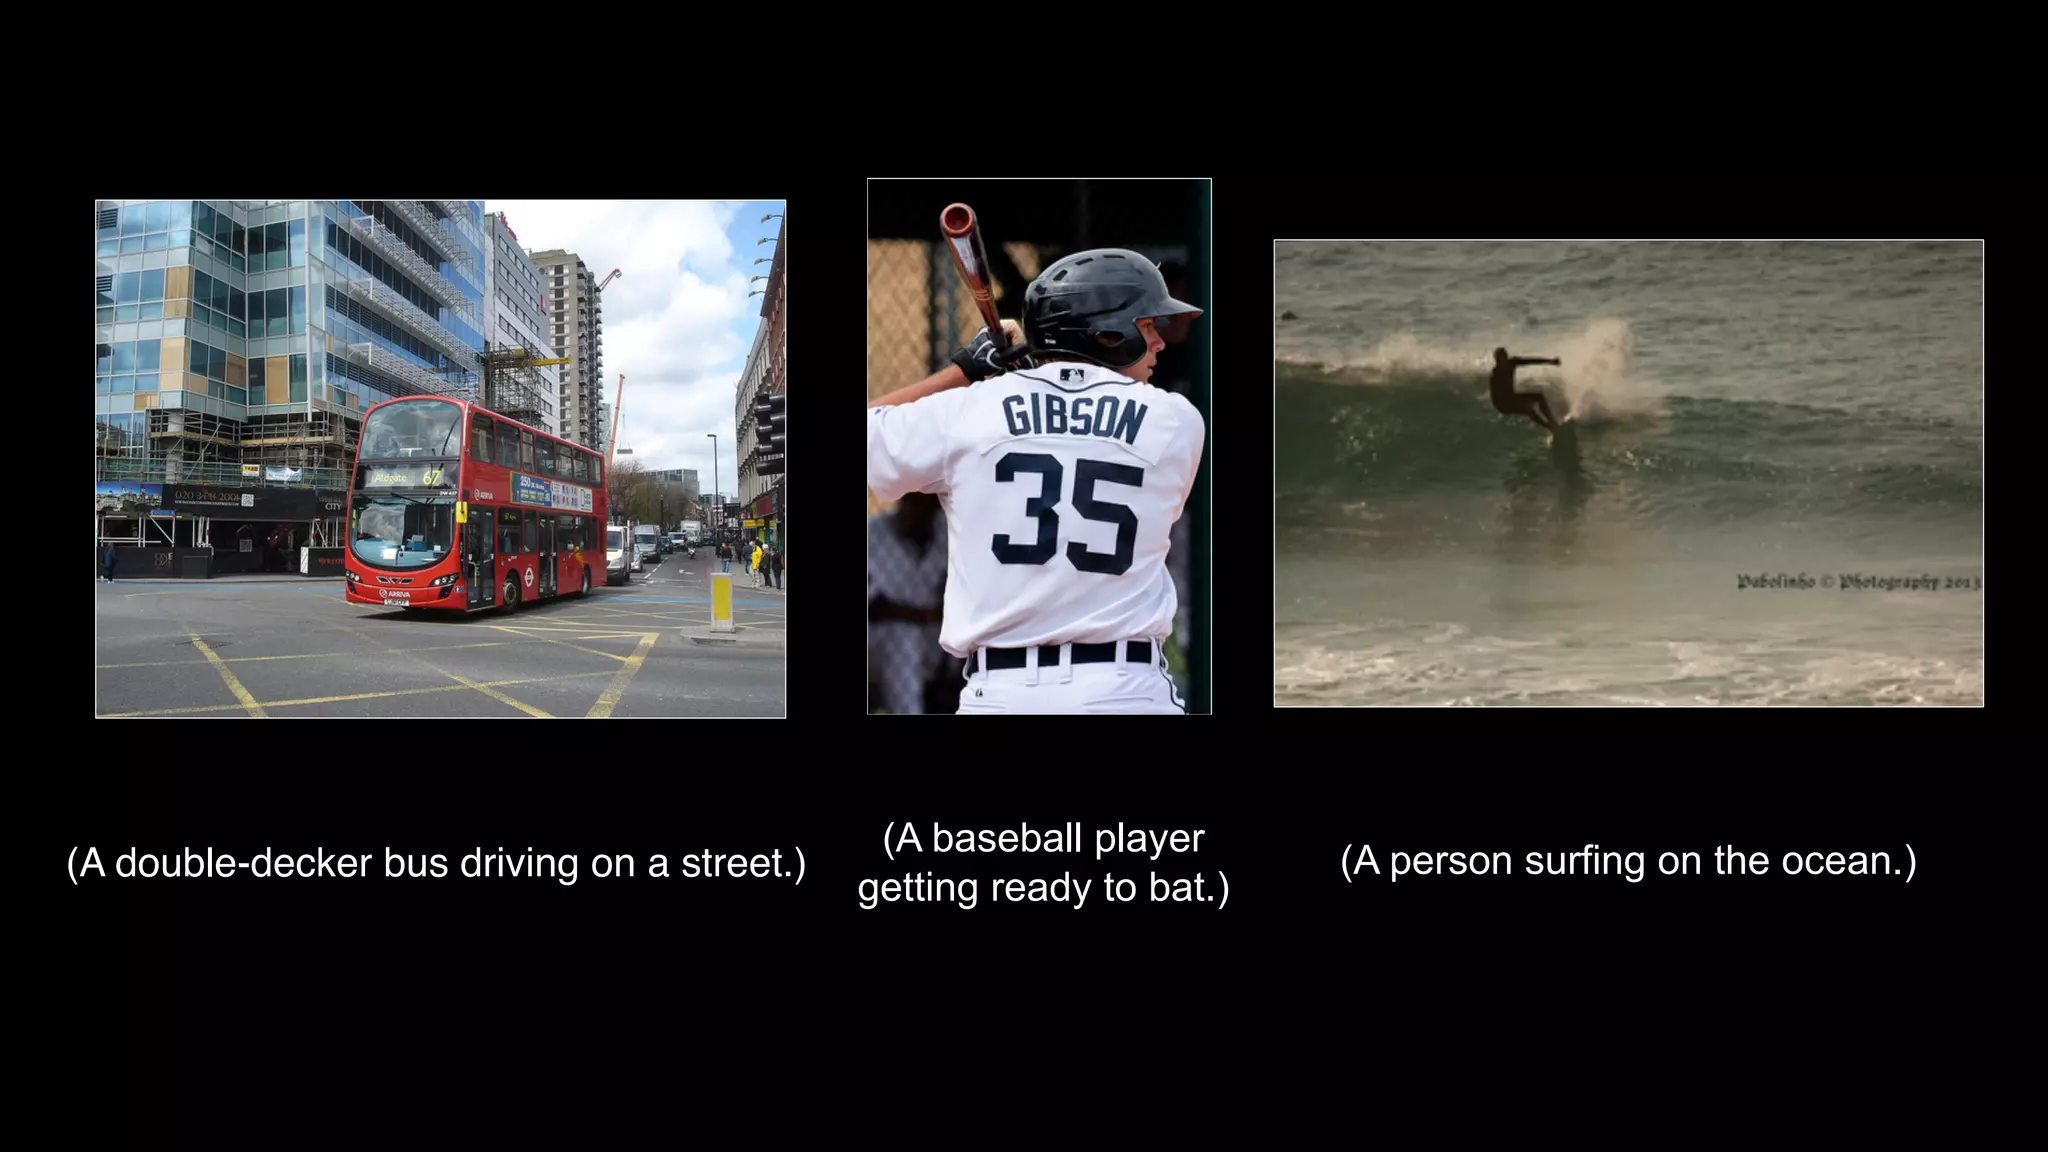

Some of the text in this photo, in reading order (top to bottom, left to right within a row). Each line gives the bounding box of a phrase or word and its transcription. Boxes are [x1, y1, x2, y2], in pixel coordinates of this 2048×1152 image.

[1002, 392, 1148, 445] GIBSON
[375, 470, 441, 485] Aldgate 67
[325, 503, 342, 511] CITY
[991, 452, 1144, 576] 35
[388, 590, 411, 598] ARRIVA
